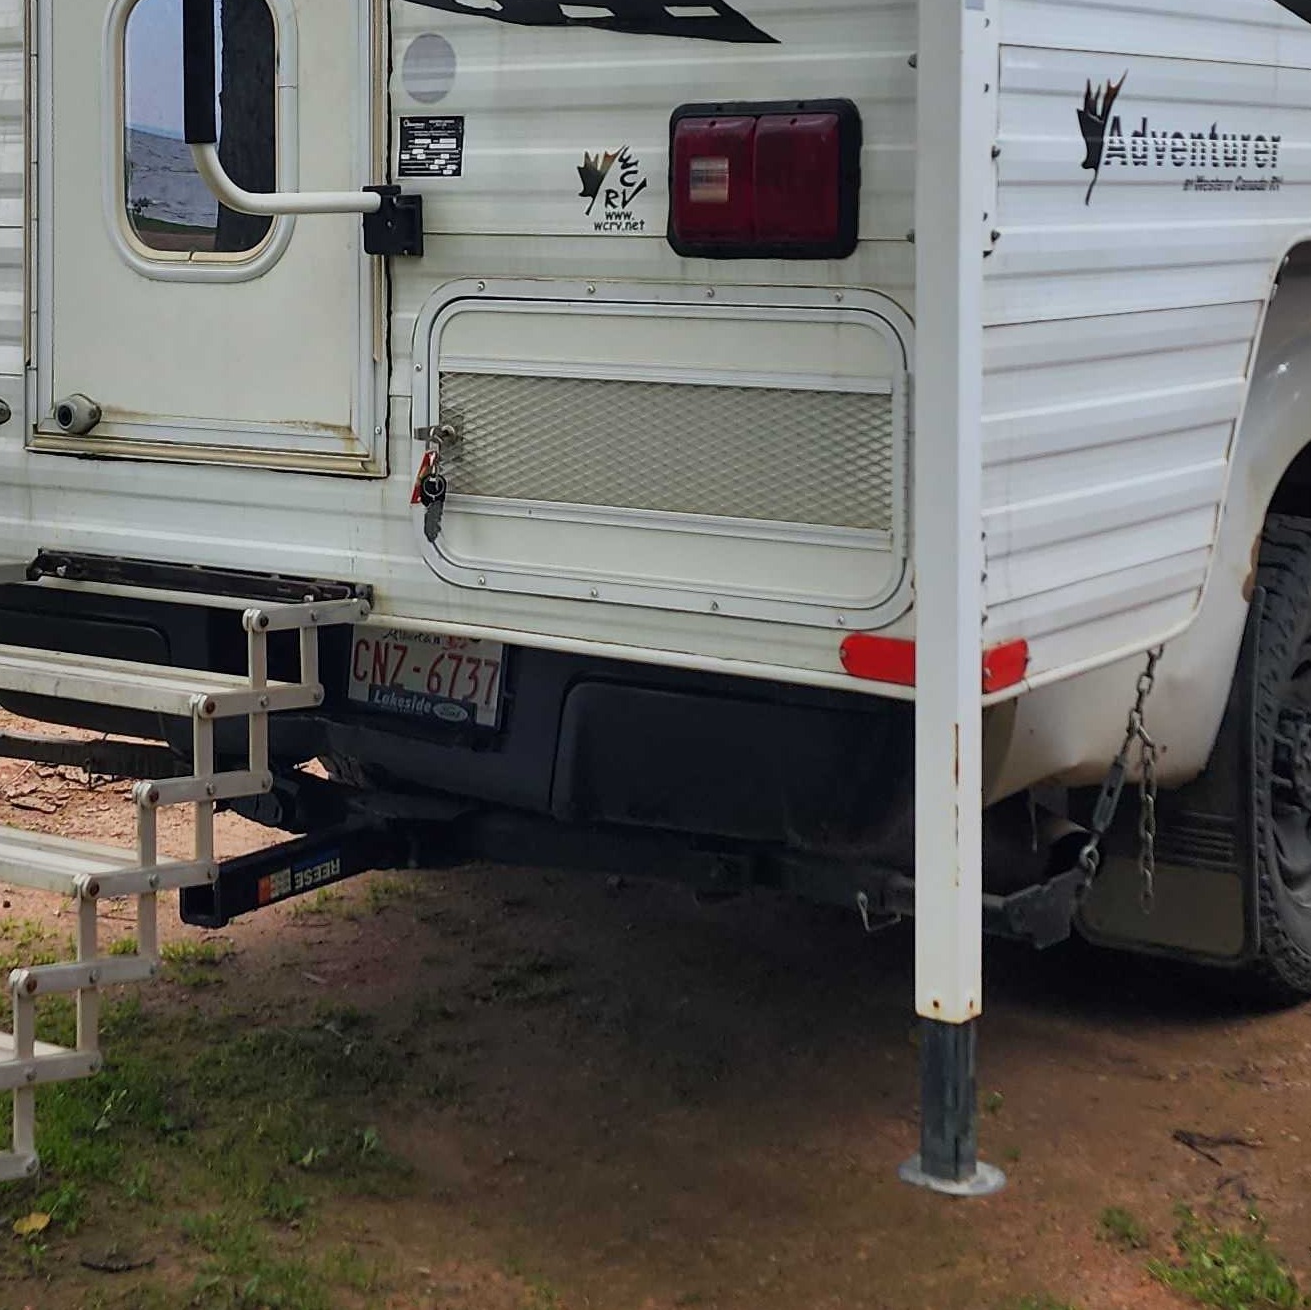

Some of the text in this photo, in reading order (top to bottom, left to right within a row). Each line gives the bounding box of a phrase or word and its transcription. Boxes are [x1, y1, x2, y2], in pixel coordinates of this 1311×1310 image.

[1103, 115, 1282, 169] Adventurer
[593, 218, 646, 231] wcrv.net
[604, 210, 636, 221] www.
[353, 638, 500, 705] CNZ-6737
[373, 689, 432, 714] Lakeside
[294, 857, 341, 889] REESE
